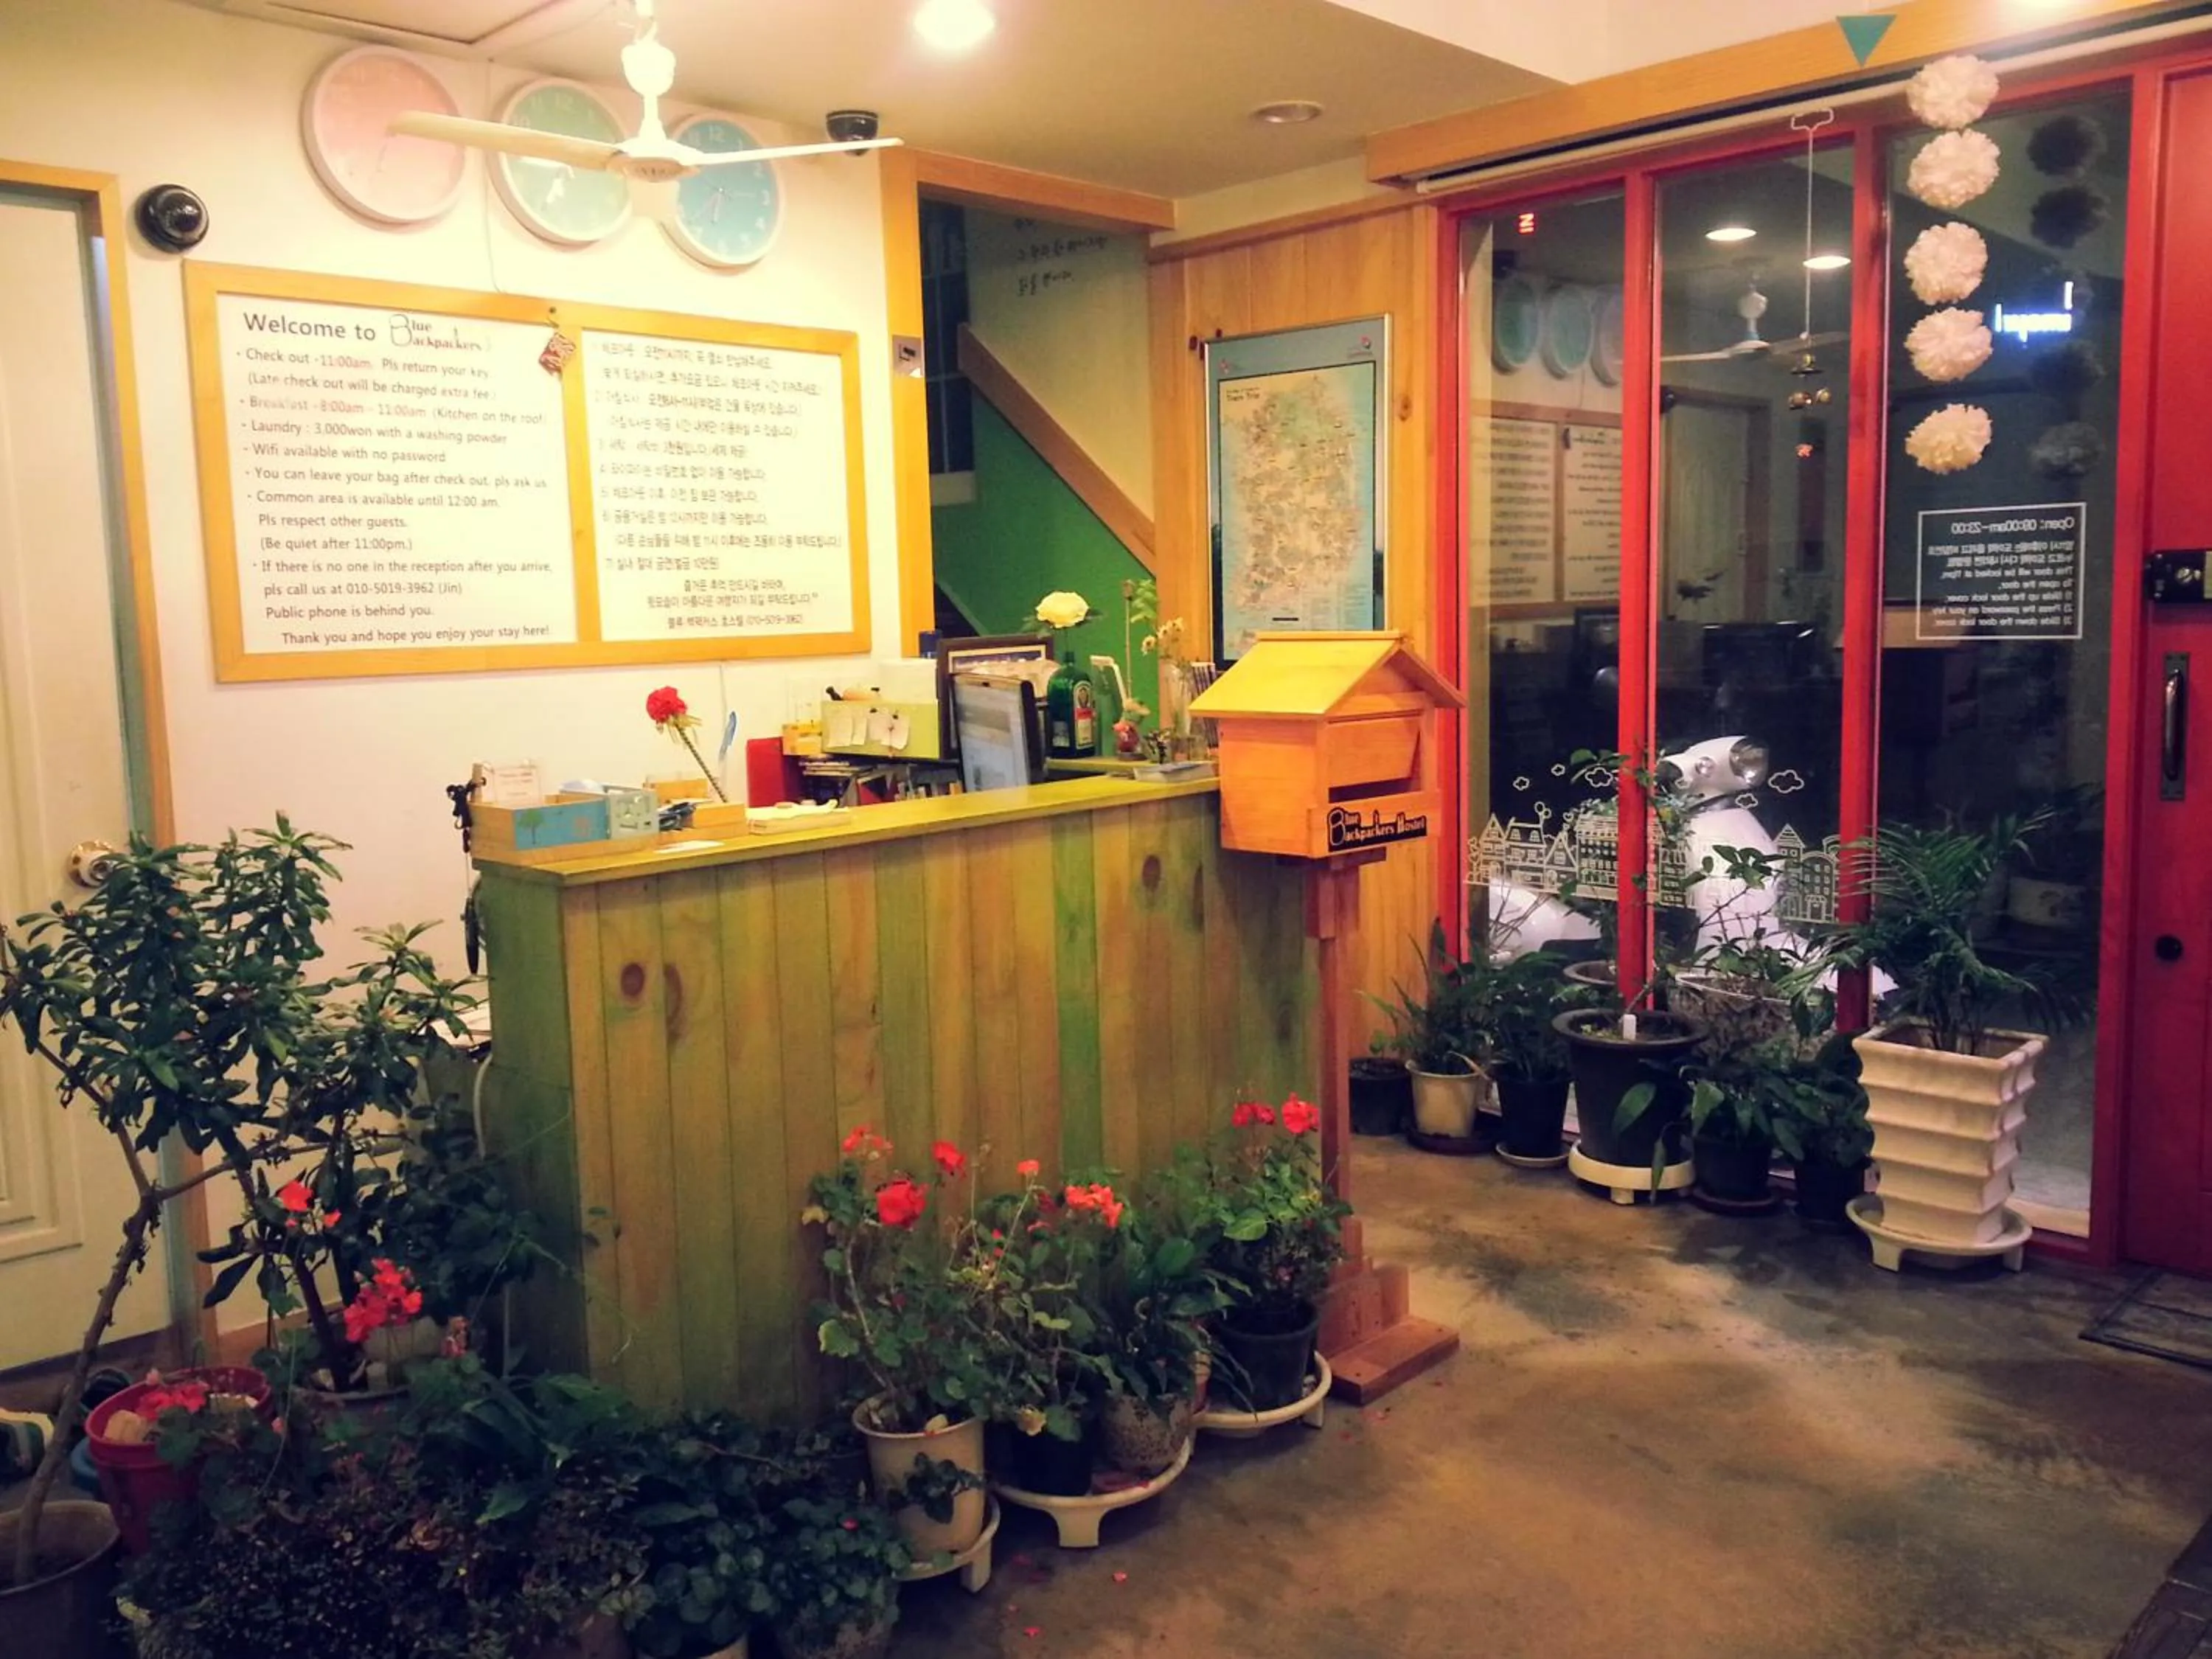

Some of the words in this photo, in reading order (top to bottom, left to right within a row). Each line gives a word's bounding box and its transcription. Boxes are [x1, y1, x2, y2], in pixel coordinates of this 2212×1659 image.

[243, 312, 347, 338] Welcome
[355, 324, 376, 341] to
[246, 347, 283, 362] Check
[288, 352, 310, 364] out
[403, 361, 438, 374] return
[442, 365, 466, 377] your
[248, 371, 280, 386] (Late
[283, 372, 319, 388] check
[323, 378, 344, 390] out
[348, 378, 369, 390] will
[372, 380, 387, 392] be
[392, 381, 437, 399] charged
[441, 385, 469, 398] extra
[482, 411, 496, 422] on
[500, 412, 517, 424] the
[251, 419, 302, 437] Laundry
[377, 426, 401, 438] with
[406, 430, 412, 439] a
[417, 429, 463, 445] washing
[252, 442, 279, 456] Wifi
[284, 445, 338, 458] available
[342, 448, 368, 459] with
[372, 450, 388, 459] no
[392, 450, 446, 464] password
[255, 467, 279, 480] You
[284, 470, 305, 480] can
[310, 467, 342, 481] leave
[346, 473, 373, 485] your
[378, 470, 400, 486] bag
[403, 471, 431, 484] after
[434, 473, 466, 485] check
[495, 476, 510, 489] pls
[514, 477, 531, 488] ask
[257, 490, 314, 503] Common
[318, 494, 344, 504] area
[349, 493, 358, 504] is
[362, 493, 414, 507] available
[418, 494, 443, 506] until
[448, 495, 477, 507] 12:00
[259, 513, 276, 526] Pls
[281, 515, 326, 529] respect
[330, 515, 363, 527] other
[260, 537, 281, 552] (Be
[285, 539, 317, 552] quiet
[321, 537, 350, 550] after
[262, 560, 271, 573] If
[276, 560, 309, 573] there
[313, 560, 323, 572] is
[327, 563, 343, 573] no
[347, 563, 369, 573] one
[373, 560, 384, 572] in
[389, 560, 408, 573] the
[411, 560, 465, 575] reception
[467, 560, 494, 571] after
[497, 562, 517, 577] you
[264, 582, 282, 599] pls
[286, 582, 307, 596] call
[313, 585, 326, 595] us
[330, 583, 343, 595] at
[438, 582, 463, 596] (Jin)
[266, 606, 305, 619] Public
[308, 605, 347, 621] phone
[351, 605, 361, 617] is
[365, 604, 406, 617] behind
[282, 631, 320, 644] Thank
[324, 633, 347, 646] you
[351, 630, 374, 642] and
[377, 628, 407, 644] hope
[411, 630, 432, 643] you
[436, 628, 467, 641] enjoy
[470, 629, 495, 641] your
[498, 627, 521, 639] stay
[523, 625, 550, 636] here!
